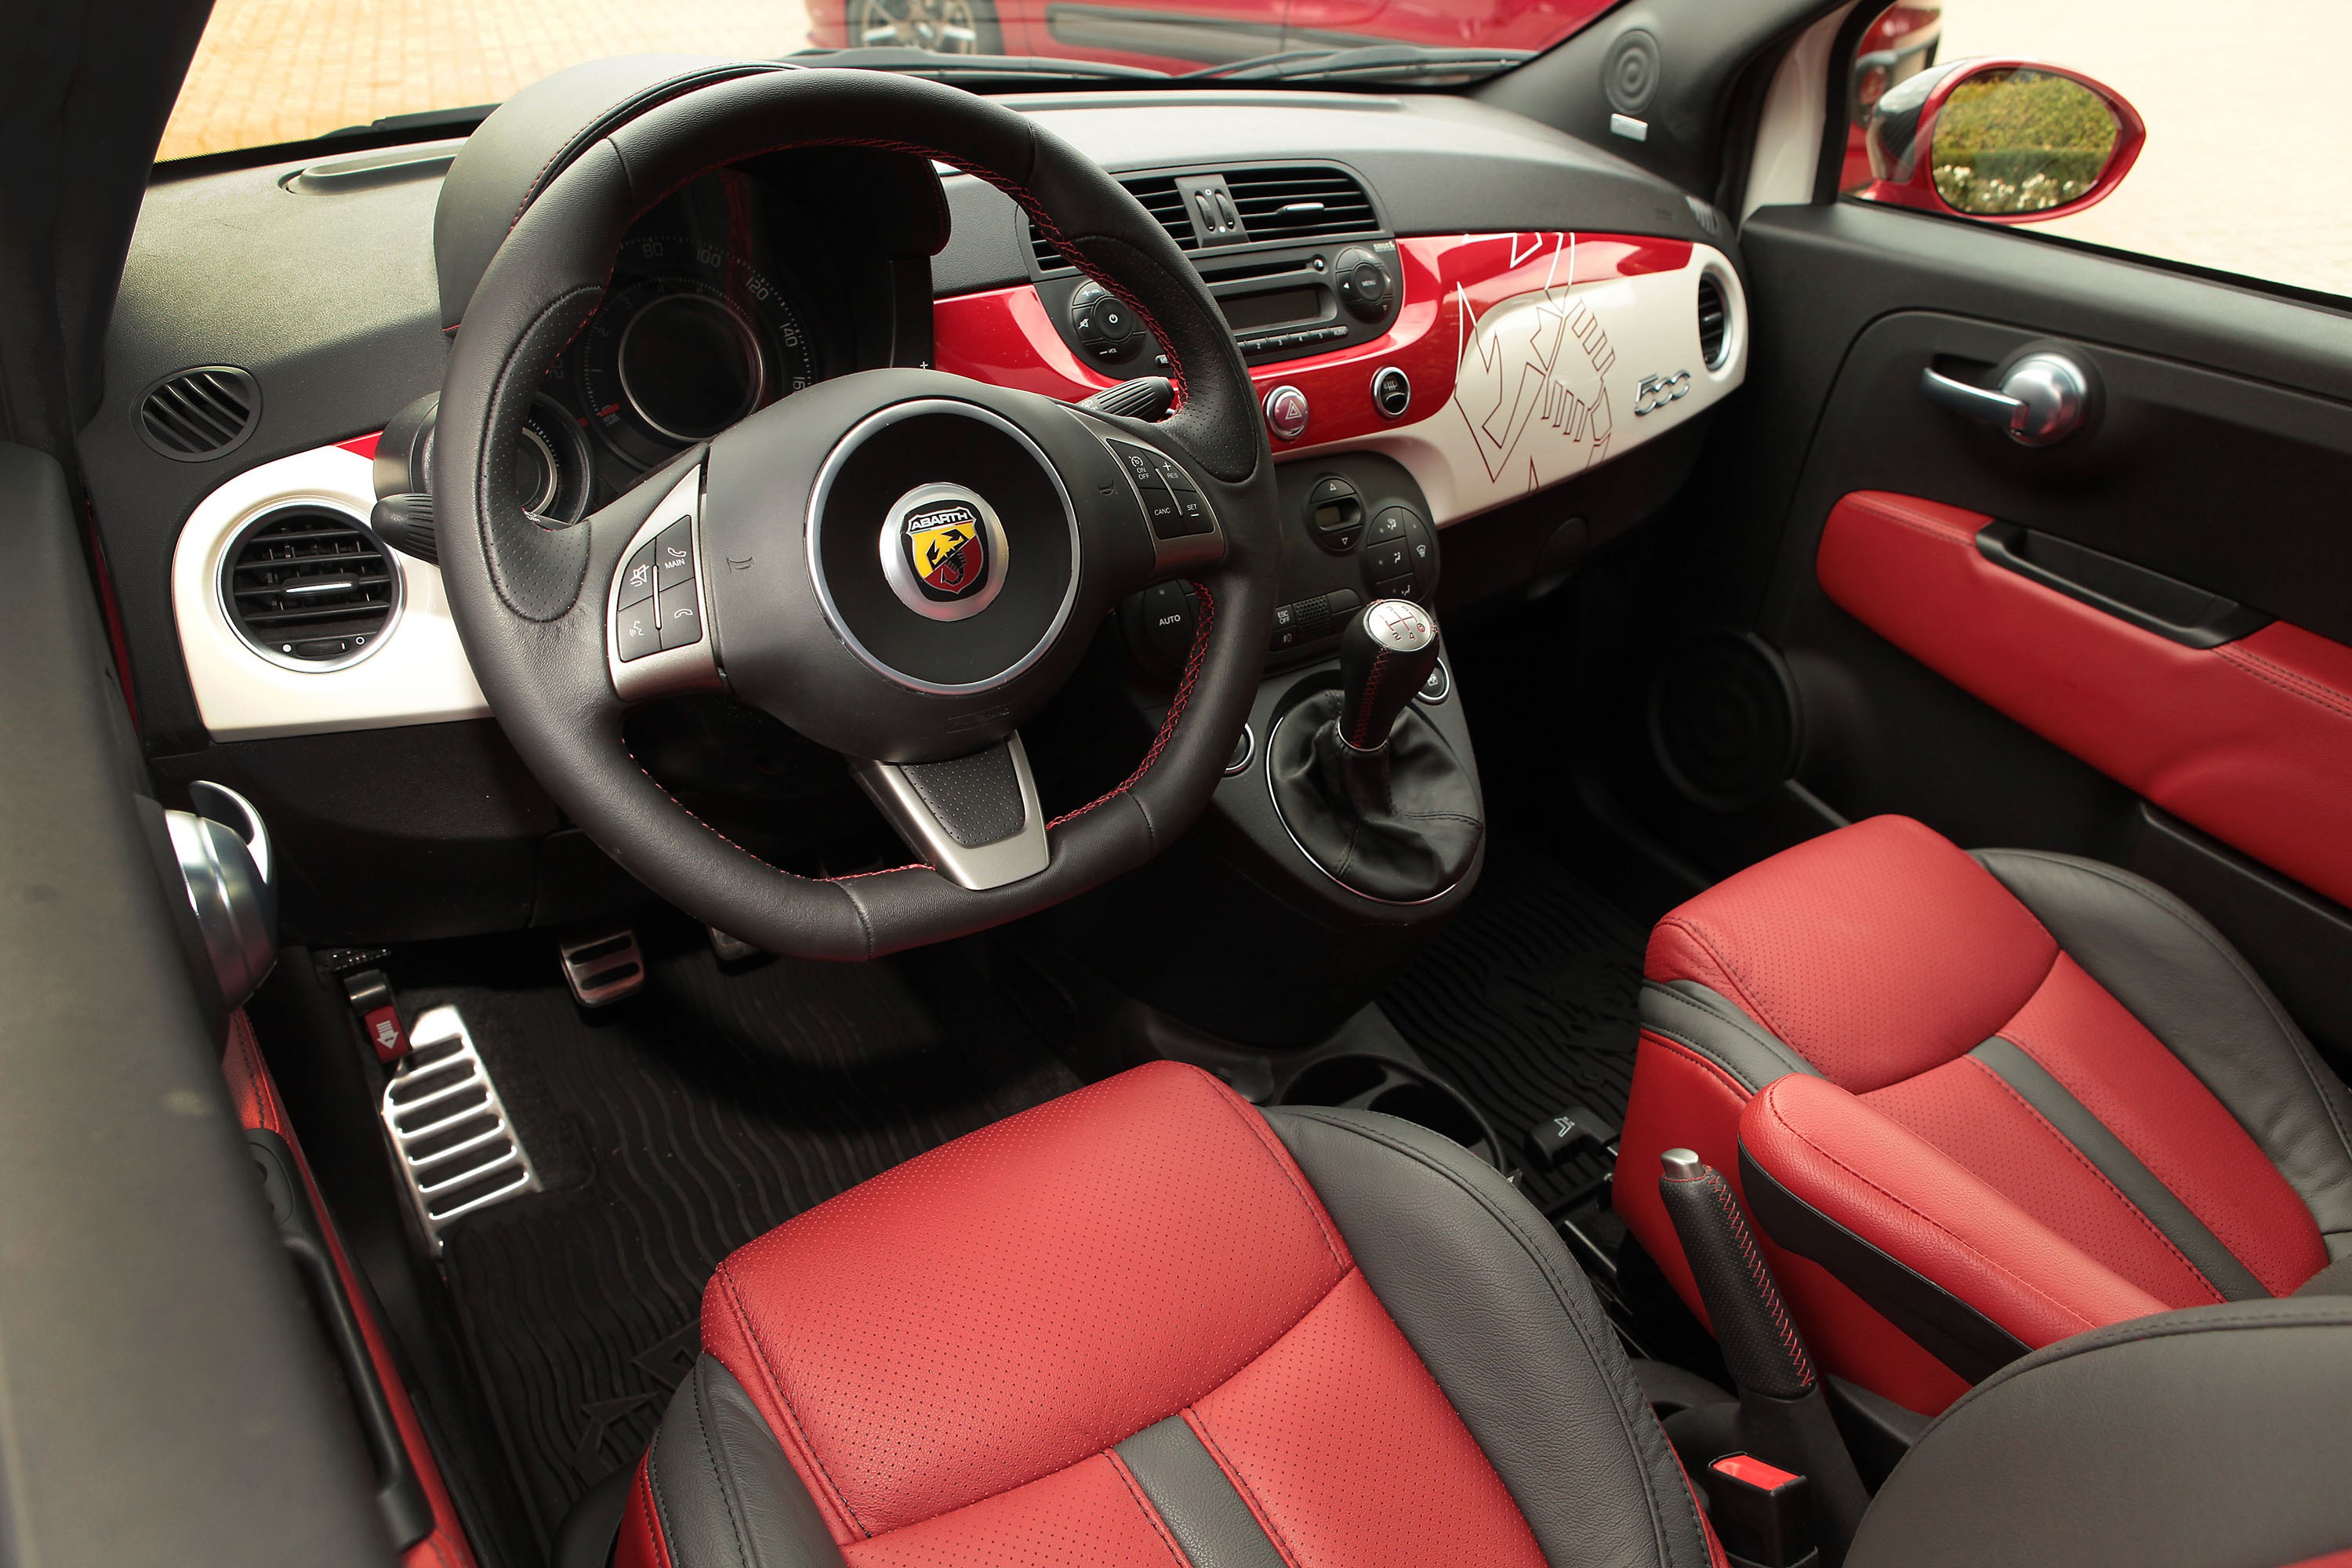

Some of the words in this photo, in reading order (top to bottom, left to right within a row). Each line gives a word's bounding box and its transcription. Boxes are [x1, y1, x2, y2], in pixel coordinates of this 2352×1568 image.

[642, 242, 663, 258] 80
[696, 247, 721, 267] 100
[746, 277, 769, 300] 120
[779, 323, 798, 347] 140
[793, 376, 805, 392] 16
[1635, 370, 1690, 416] 500
[1154, 507, 1171, 516] CANC
[911, 512, 968, 530] ABARTH
[664, 557, 686, 570] MAIN
[1159, 614, 1181, 626] AUTO
[1277, 610, 1290, 619] ESC
[1409, 632, 1416, 641] 4
